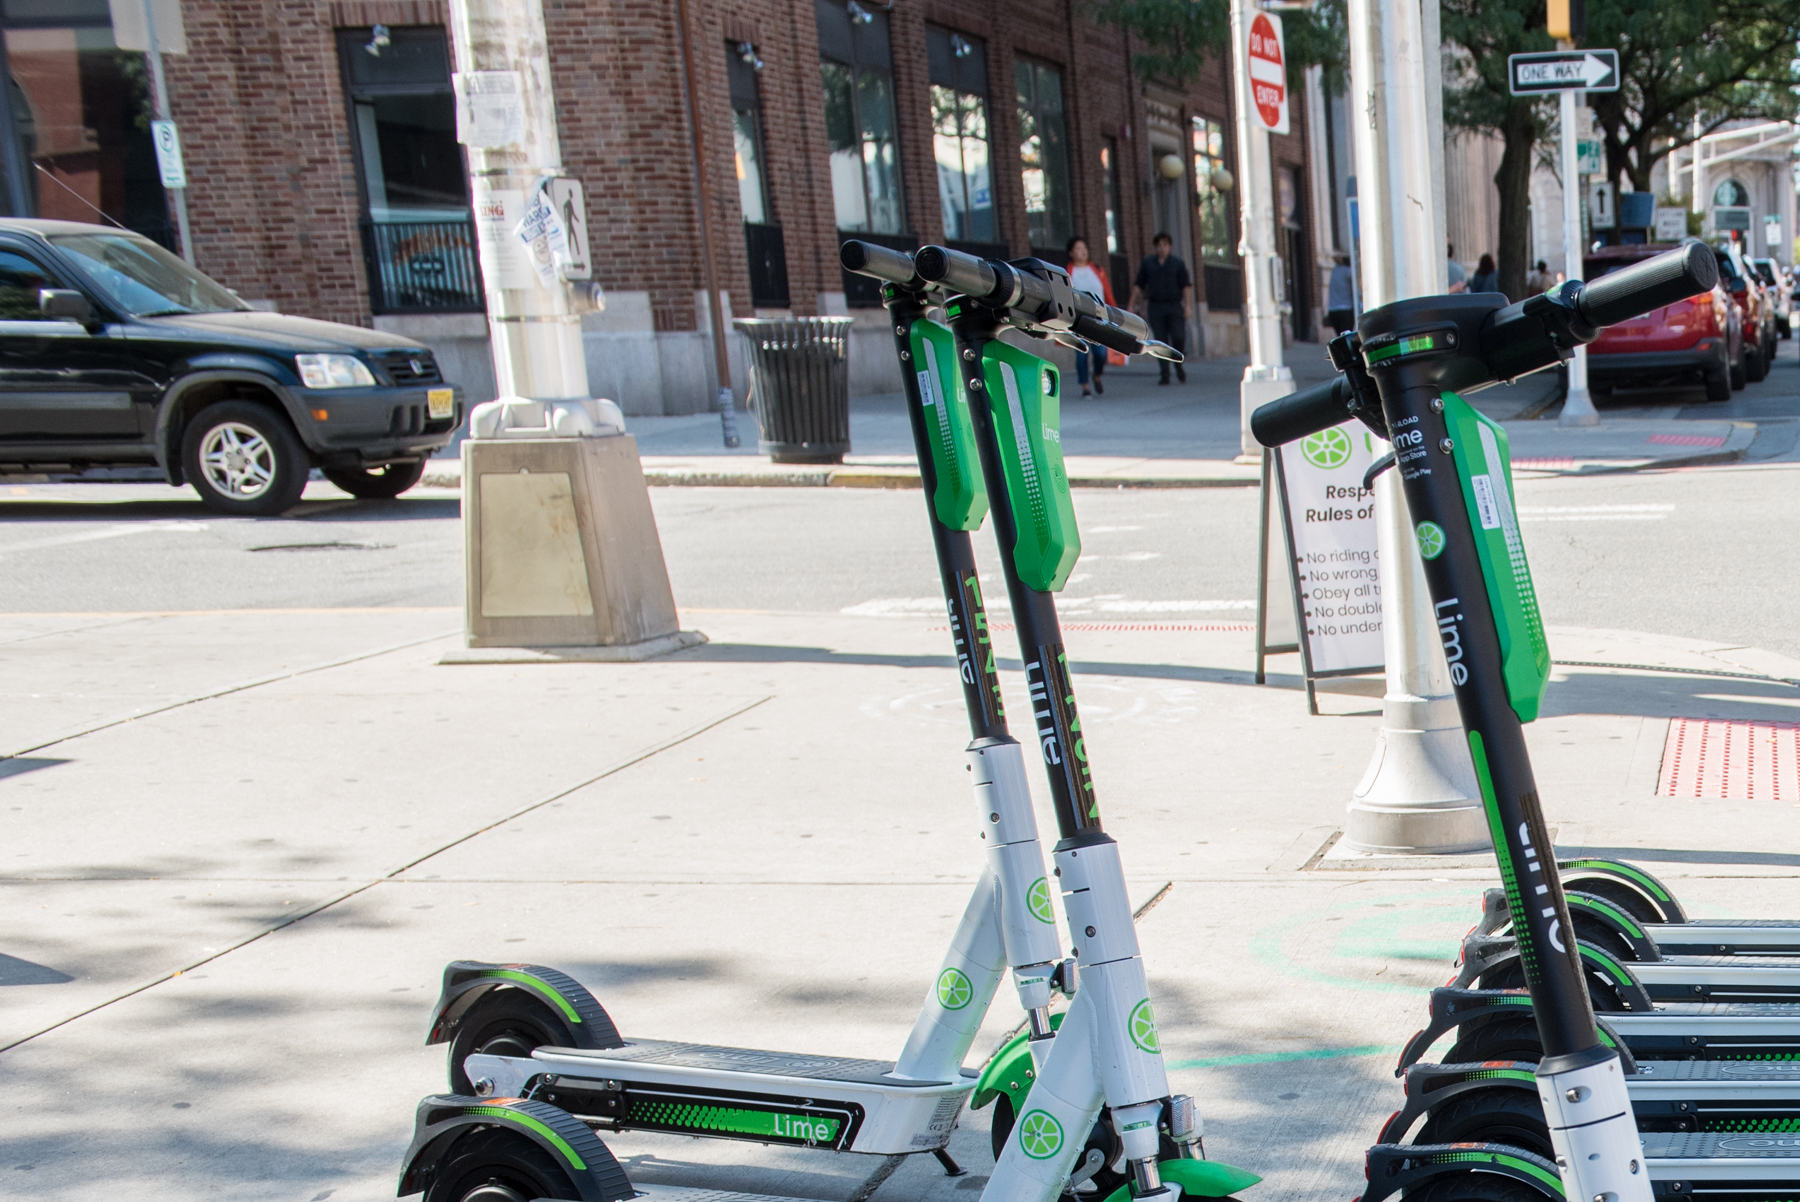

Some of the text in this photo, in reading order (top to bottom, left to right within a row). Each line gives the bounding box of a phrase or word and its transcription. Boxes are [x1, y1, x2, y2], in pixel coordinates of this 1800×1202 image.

[1251, 32, 1279, 58] DO NOT
[1521, 62, 1583, 80] ONE WAY
[1256, 85, 1279, 108] ENTER
[1042, 422, 1060, 444] Lime
[1393, 429, 1423, 448] ime
[1410, 450, 1427, 461] Store
[1420, 468, 1432, 476] Play
[1305, 504, 1374, 523] Rules of
[1307, 552, 1326, 564] No
[1330, 549, 1370, 564] riding
[1309, 570, 1329, 582] No
[1312, 587, 1350, 601] Obey
[1354, 584, 1370, 597] all
[1315, 606, 1334, 618] No
[1318, 624, 1337, 636] No
[1435, 597, 1469, 687] Lime
[774, 1113, 830, 1142] Lime
